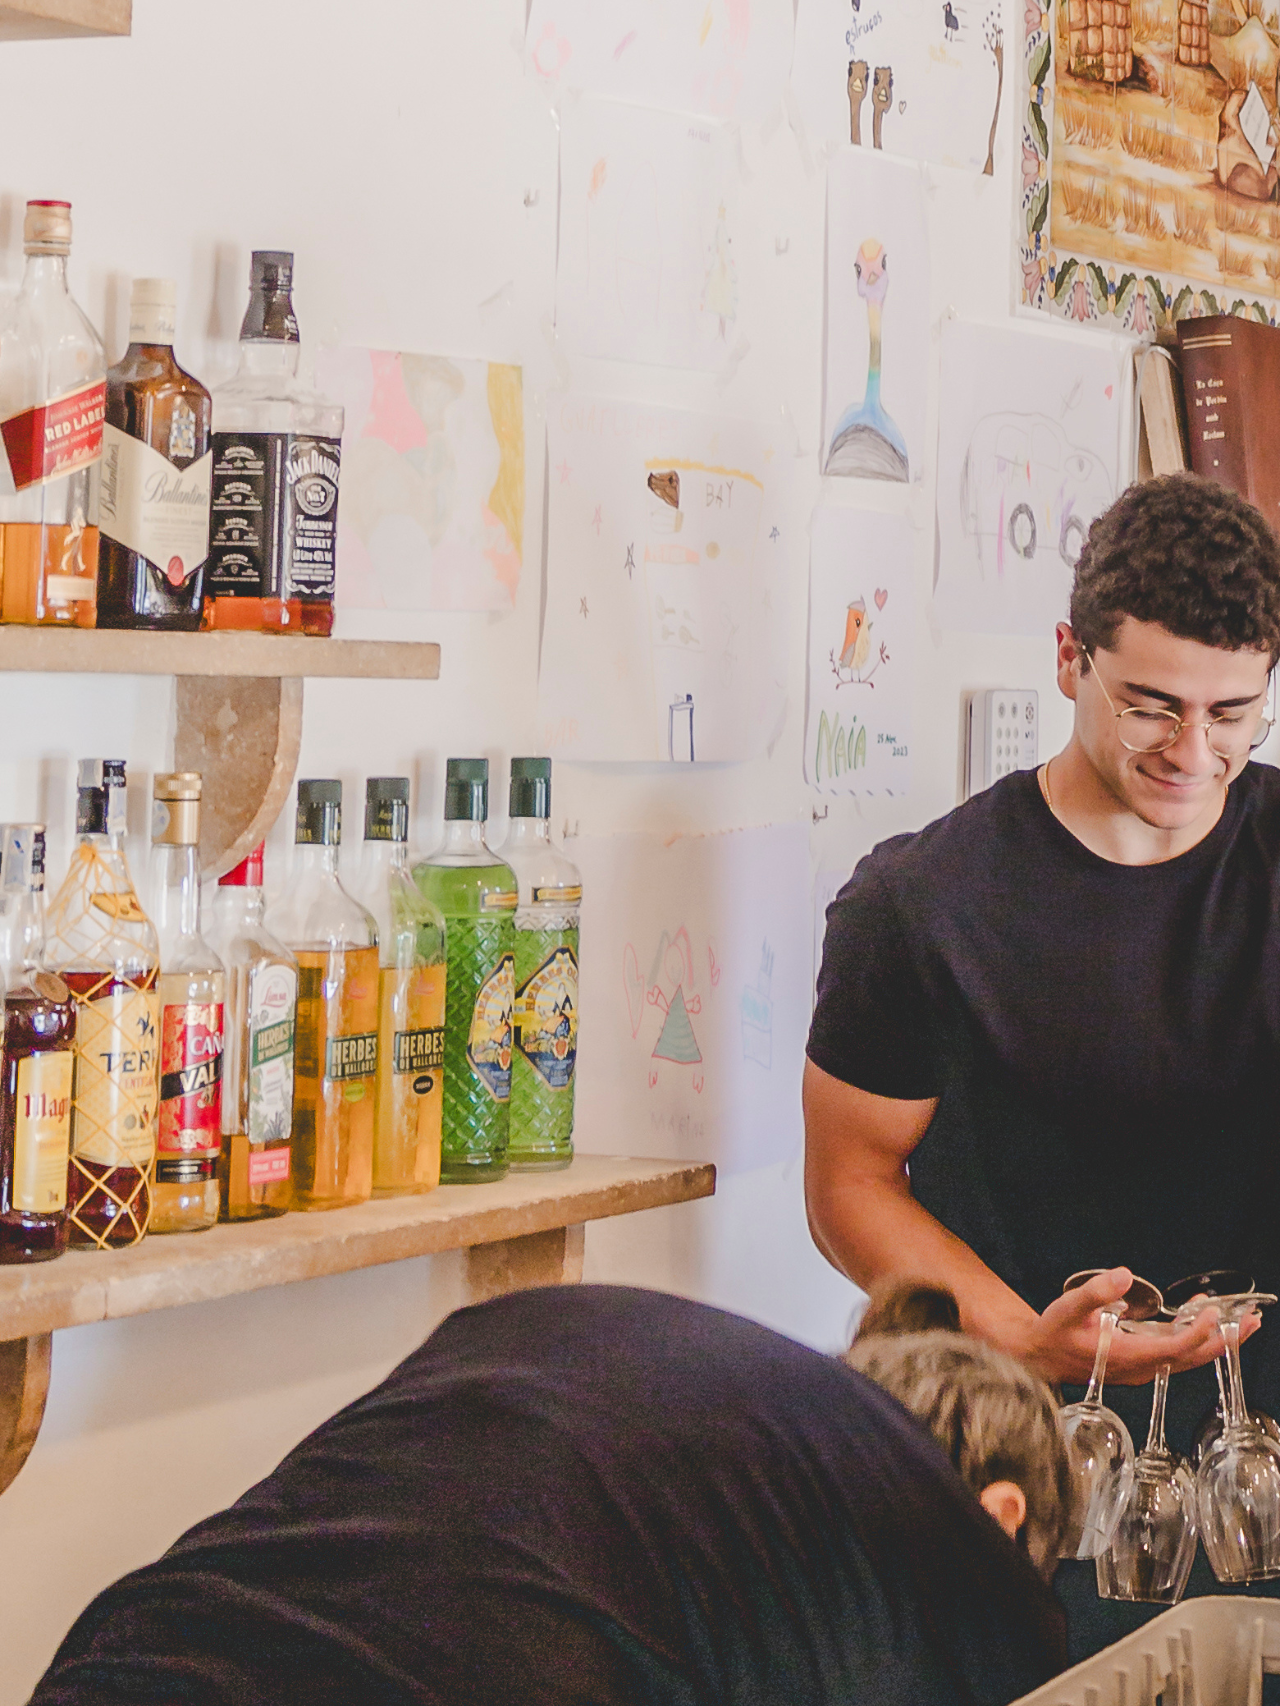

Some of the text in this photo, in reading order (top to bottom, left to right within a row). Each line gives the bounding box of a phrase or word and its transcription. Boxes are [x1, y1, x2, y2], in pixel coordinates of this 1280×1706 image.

[45, 421, 72, 442] RED
[892, 745, 909, 757] 2023
[331, 1037, 377, 1067] HERBES
[400, 1031, 445, 1058] HERBES
